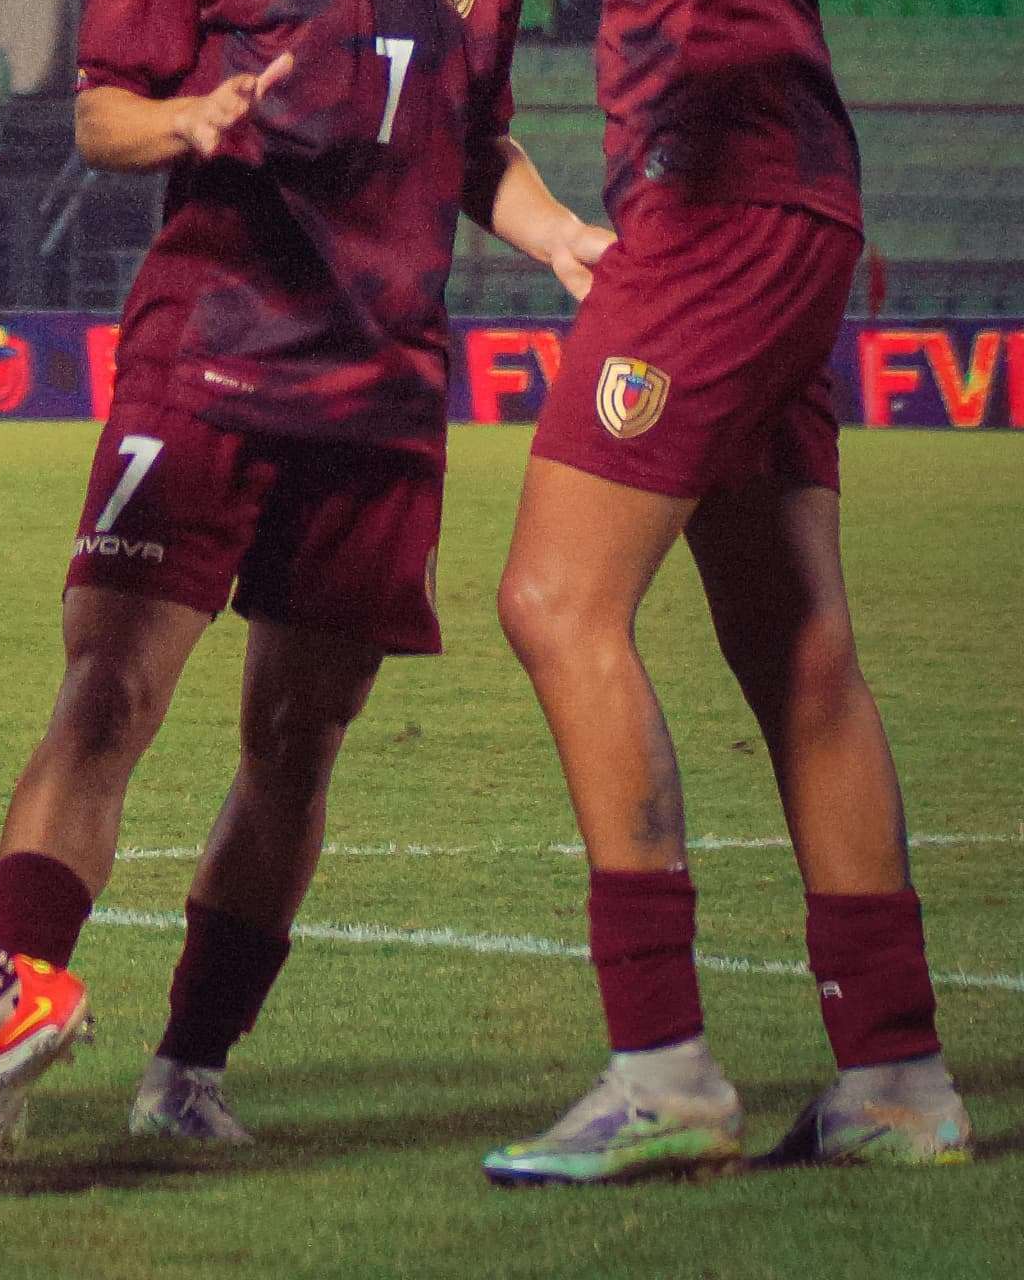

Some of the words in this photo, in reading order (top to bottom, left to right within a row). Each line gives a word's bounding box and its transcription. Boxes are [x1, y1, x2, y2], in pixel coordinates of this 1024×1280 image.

[375, 35, 415, 144] 7
[858, 329, 1024, 429] FV
[95, 433, 165, 533] 7
